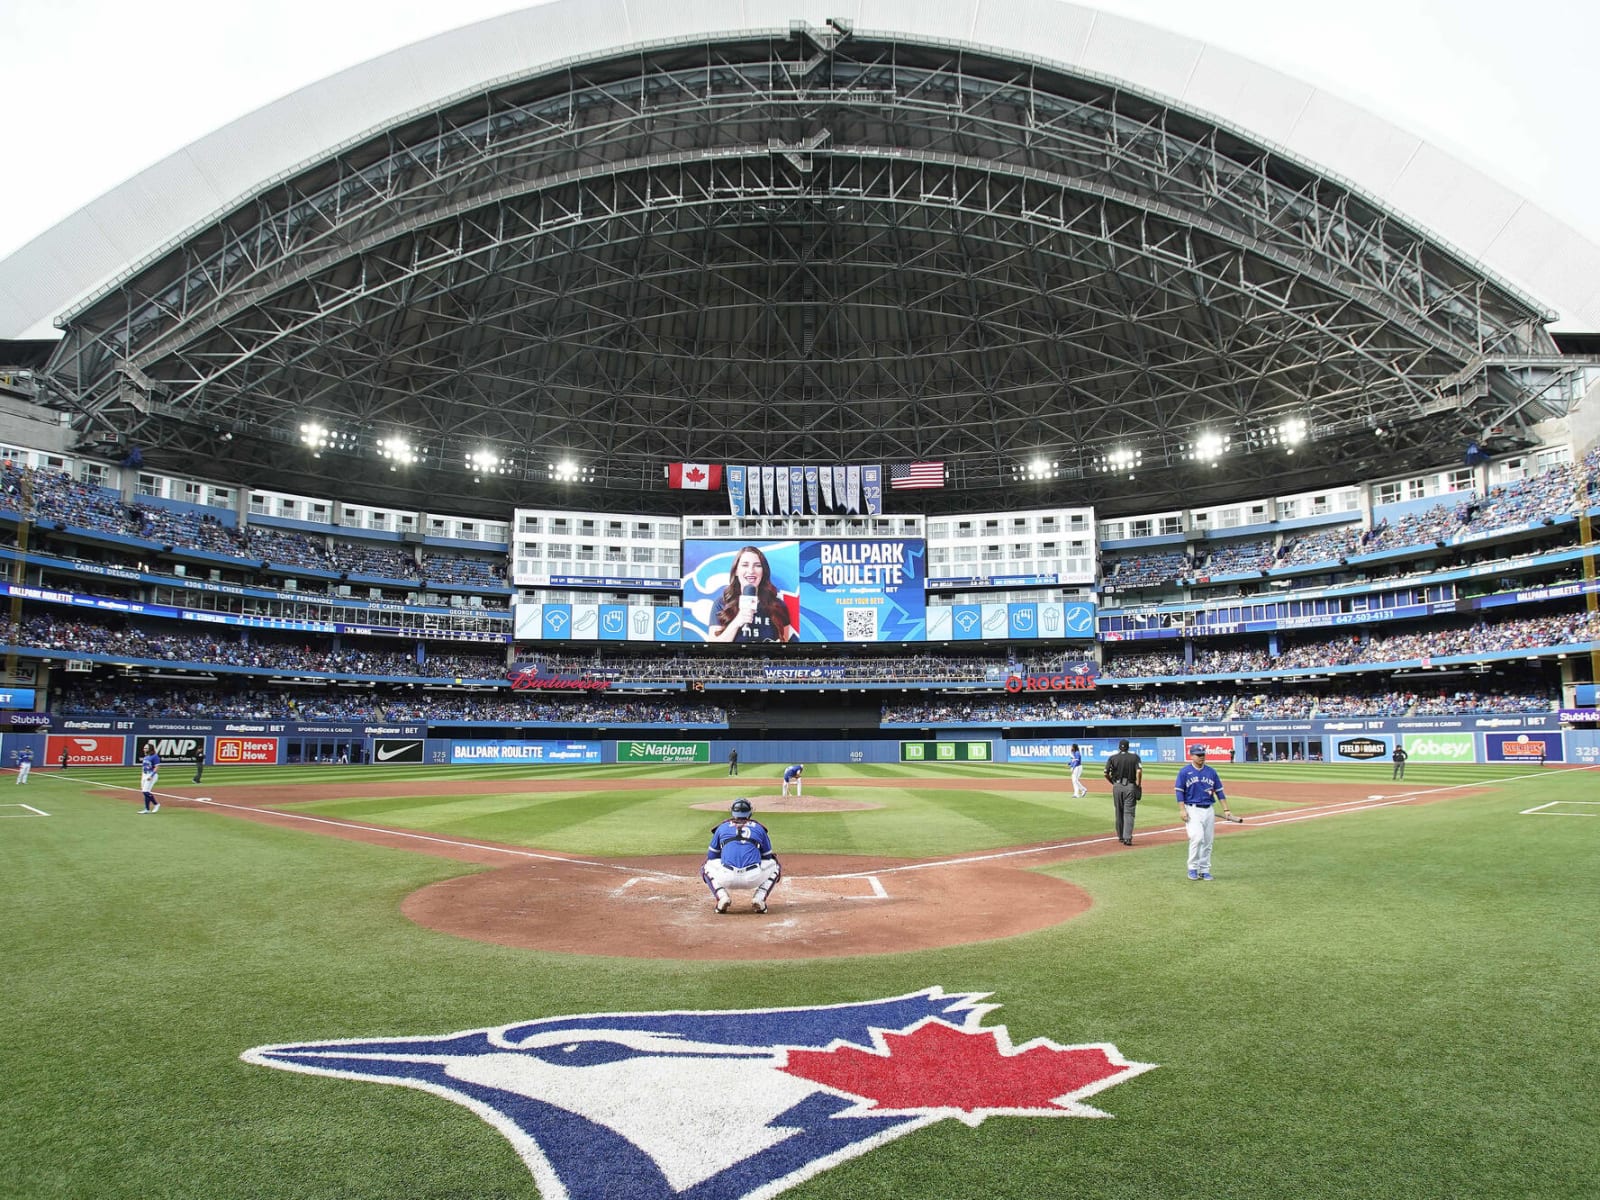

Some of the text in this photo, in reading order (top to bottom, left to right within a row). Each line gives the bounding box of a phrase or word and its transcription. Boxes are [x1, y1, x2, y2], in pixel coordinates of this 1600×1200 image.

[863, 486, 881, 499] 32
[820, 543, 904, 565] BALLPARK
[75, 563, 141, 580] CARLOS DELGADO
[822, 564, 903, 585] ROULETTE
[276, 592, 294, 600] TONY
[764, 669, 811, 678] WESTJET
[506, 672, 612, 690] Budweiser
[1025, 676, 1097, 691] ROGERS
[10, 715, 50, 724] StubHub
[1528, 717, 1546, 726] BET
[1560, 712, 1600, 722] StubHub
[64, 720, 111, 730] theScore
[225, 724, 285, 733] theScore BET
[1368, 721, 1384, 729] BET
[364, 726, 400, 735] theScore
[243, 742, 274, 751] Here's
[908, 745, 922, 757] TD
[939, 745, 953, 757] TD
[970, 745, 985, 757] TD
[1010, 745, 1051, 758] BALLPARK
[1340, 745, 1385, 753] FIELD ROAST
[1575, 746, 1600, 756] 328
[243, 752, 269, 760] How.
[432, 751, 446, 759] 375
[454, 745, 543, 759] BALLPARK ROULETTE
